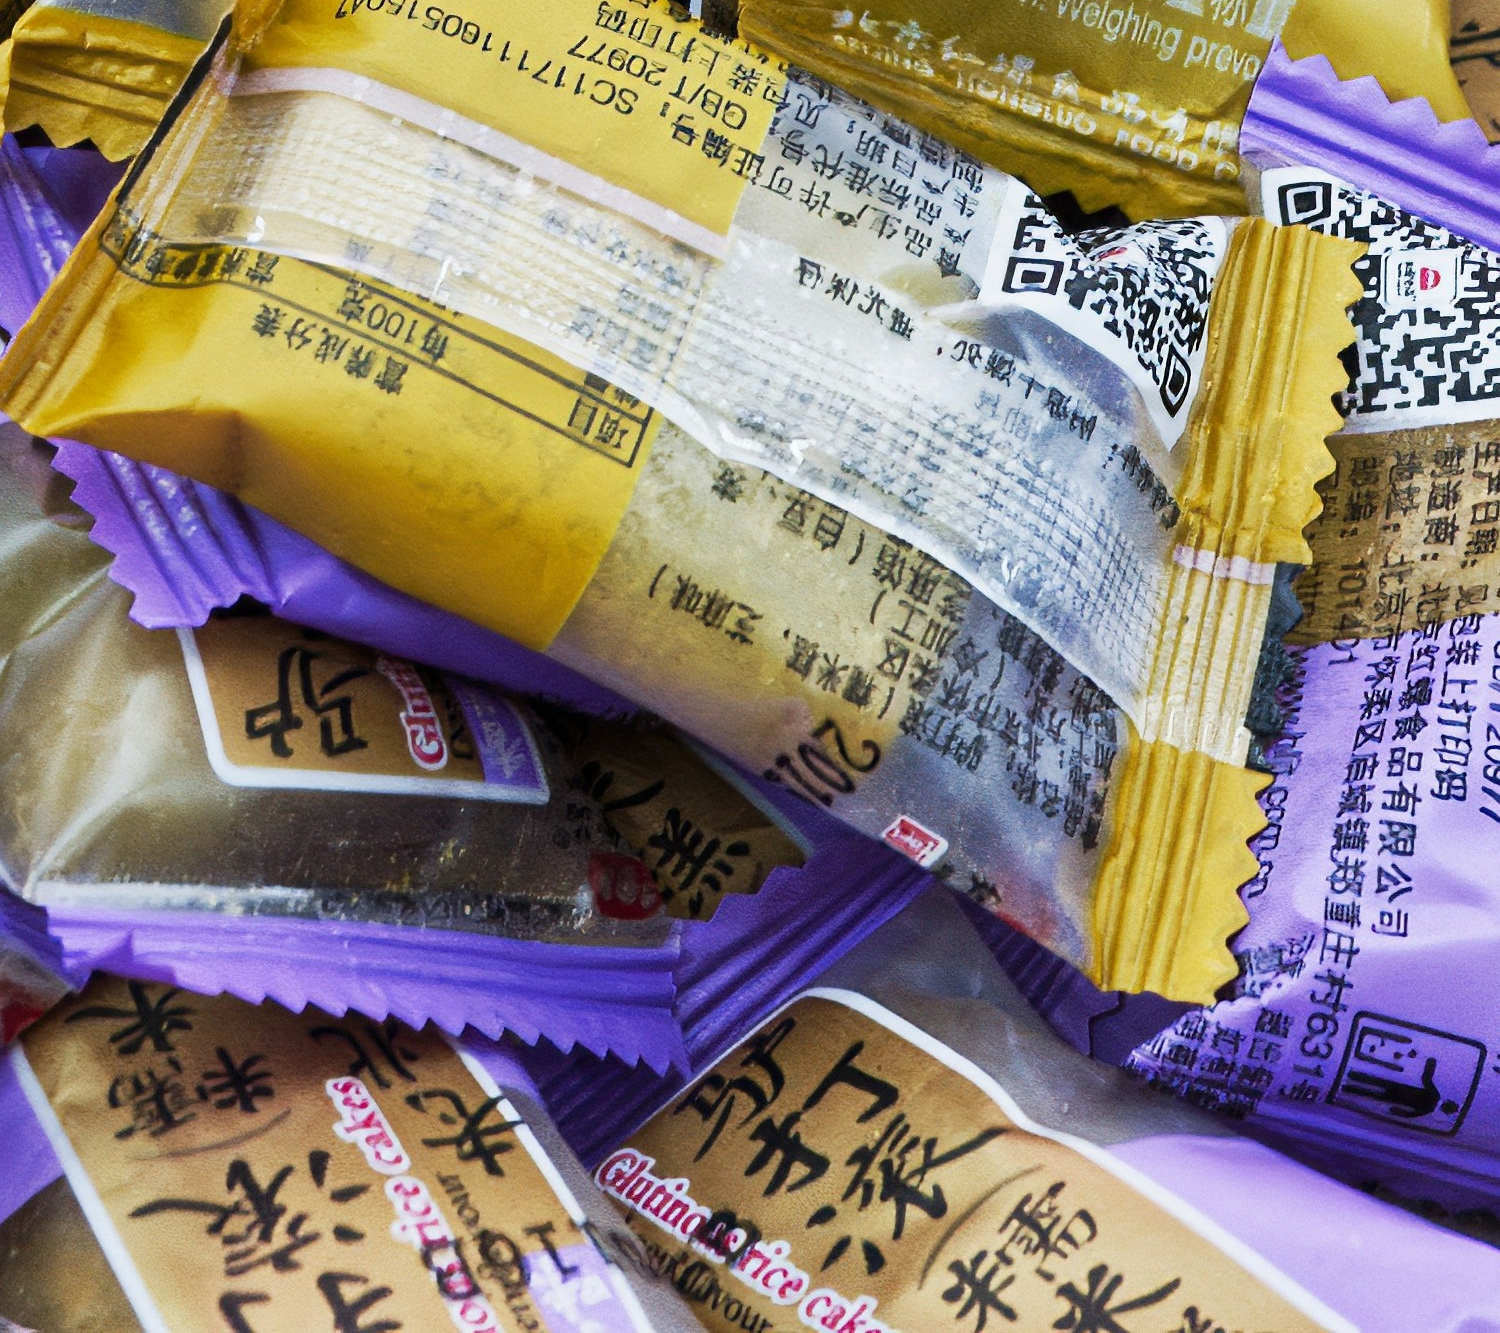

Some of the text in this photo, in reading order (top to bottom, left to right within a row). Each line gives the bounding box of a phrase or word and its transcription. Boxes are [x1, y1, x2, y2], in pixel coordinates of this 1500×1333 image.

[566, 25, 667, 93] 20977
[1183, 36, 1262, 82] preva
[664, 72, 752, 132] GB/T
[1371, 579, 1443, 939] 北京红螺食品有限公司
[330, 1077, 405, 1169] cakes
[672, 1016, 1006, 1275] 驴打滚
